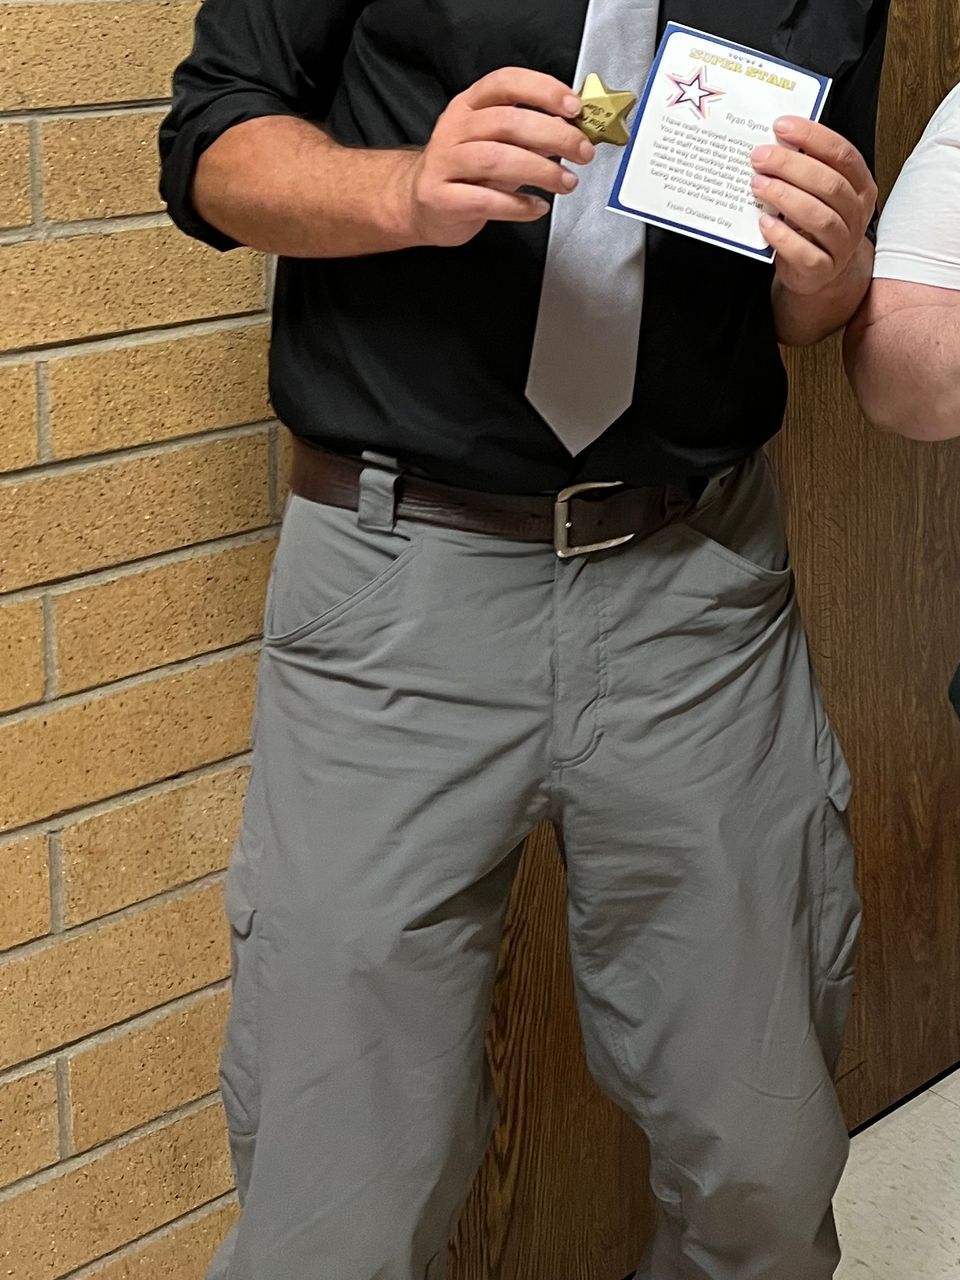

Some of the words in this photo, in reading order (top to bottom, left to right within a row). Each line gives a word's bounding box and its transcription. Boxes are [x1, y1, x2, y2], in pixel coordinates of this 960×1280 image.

[689, 48, 743, 73] SUPER
[745, 66, 797, 91] STAR!
[726, 112, 745, 125] Ryan
